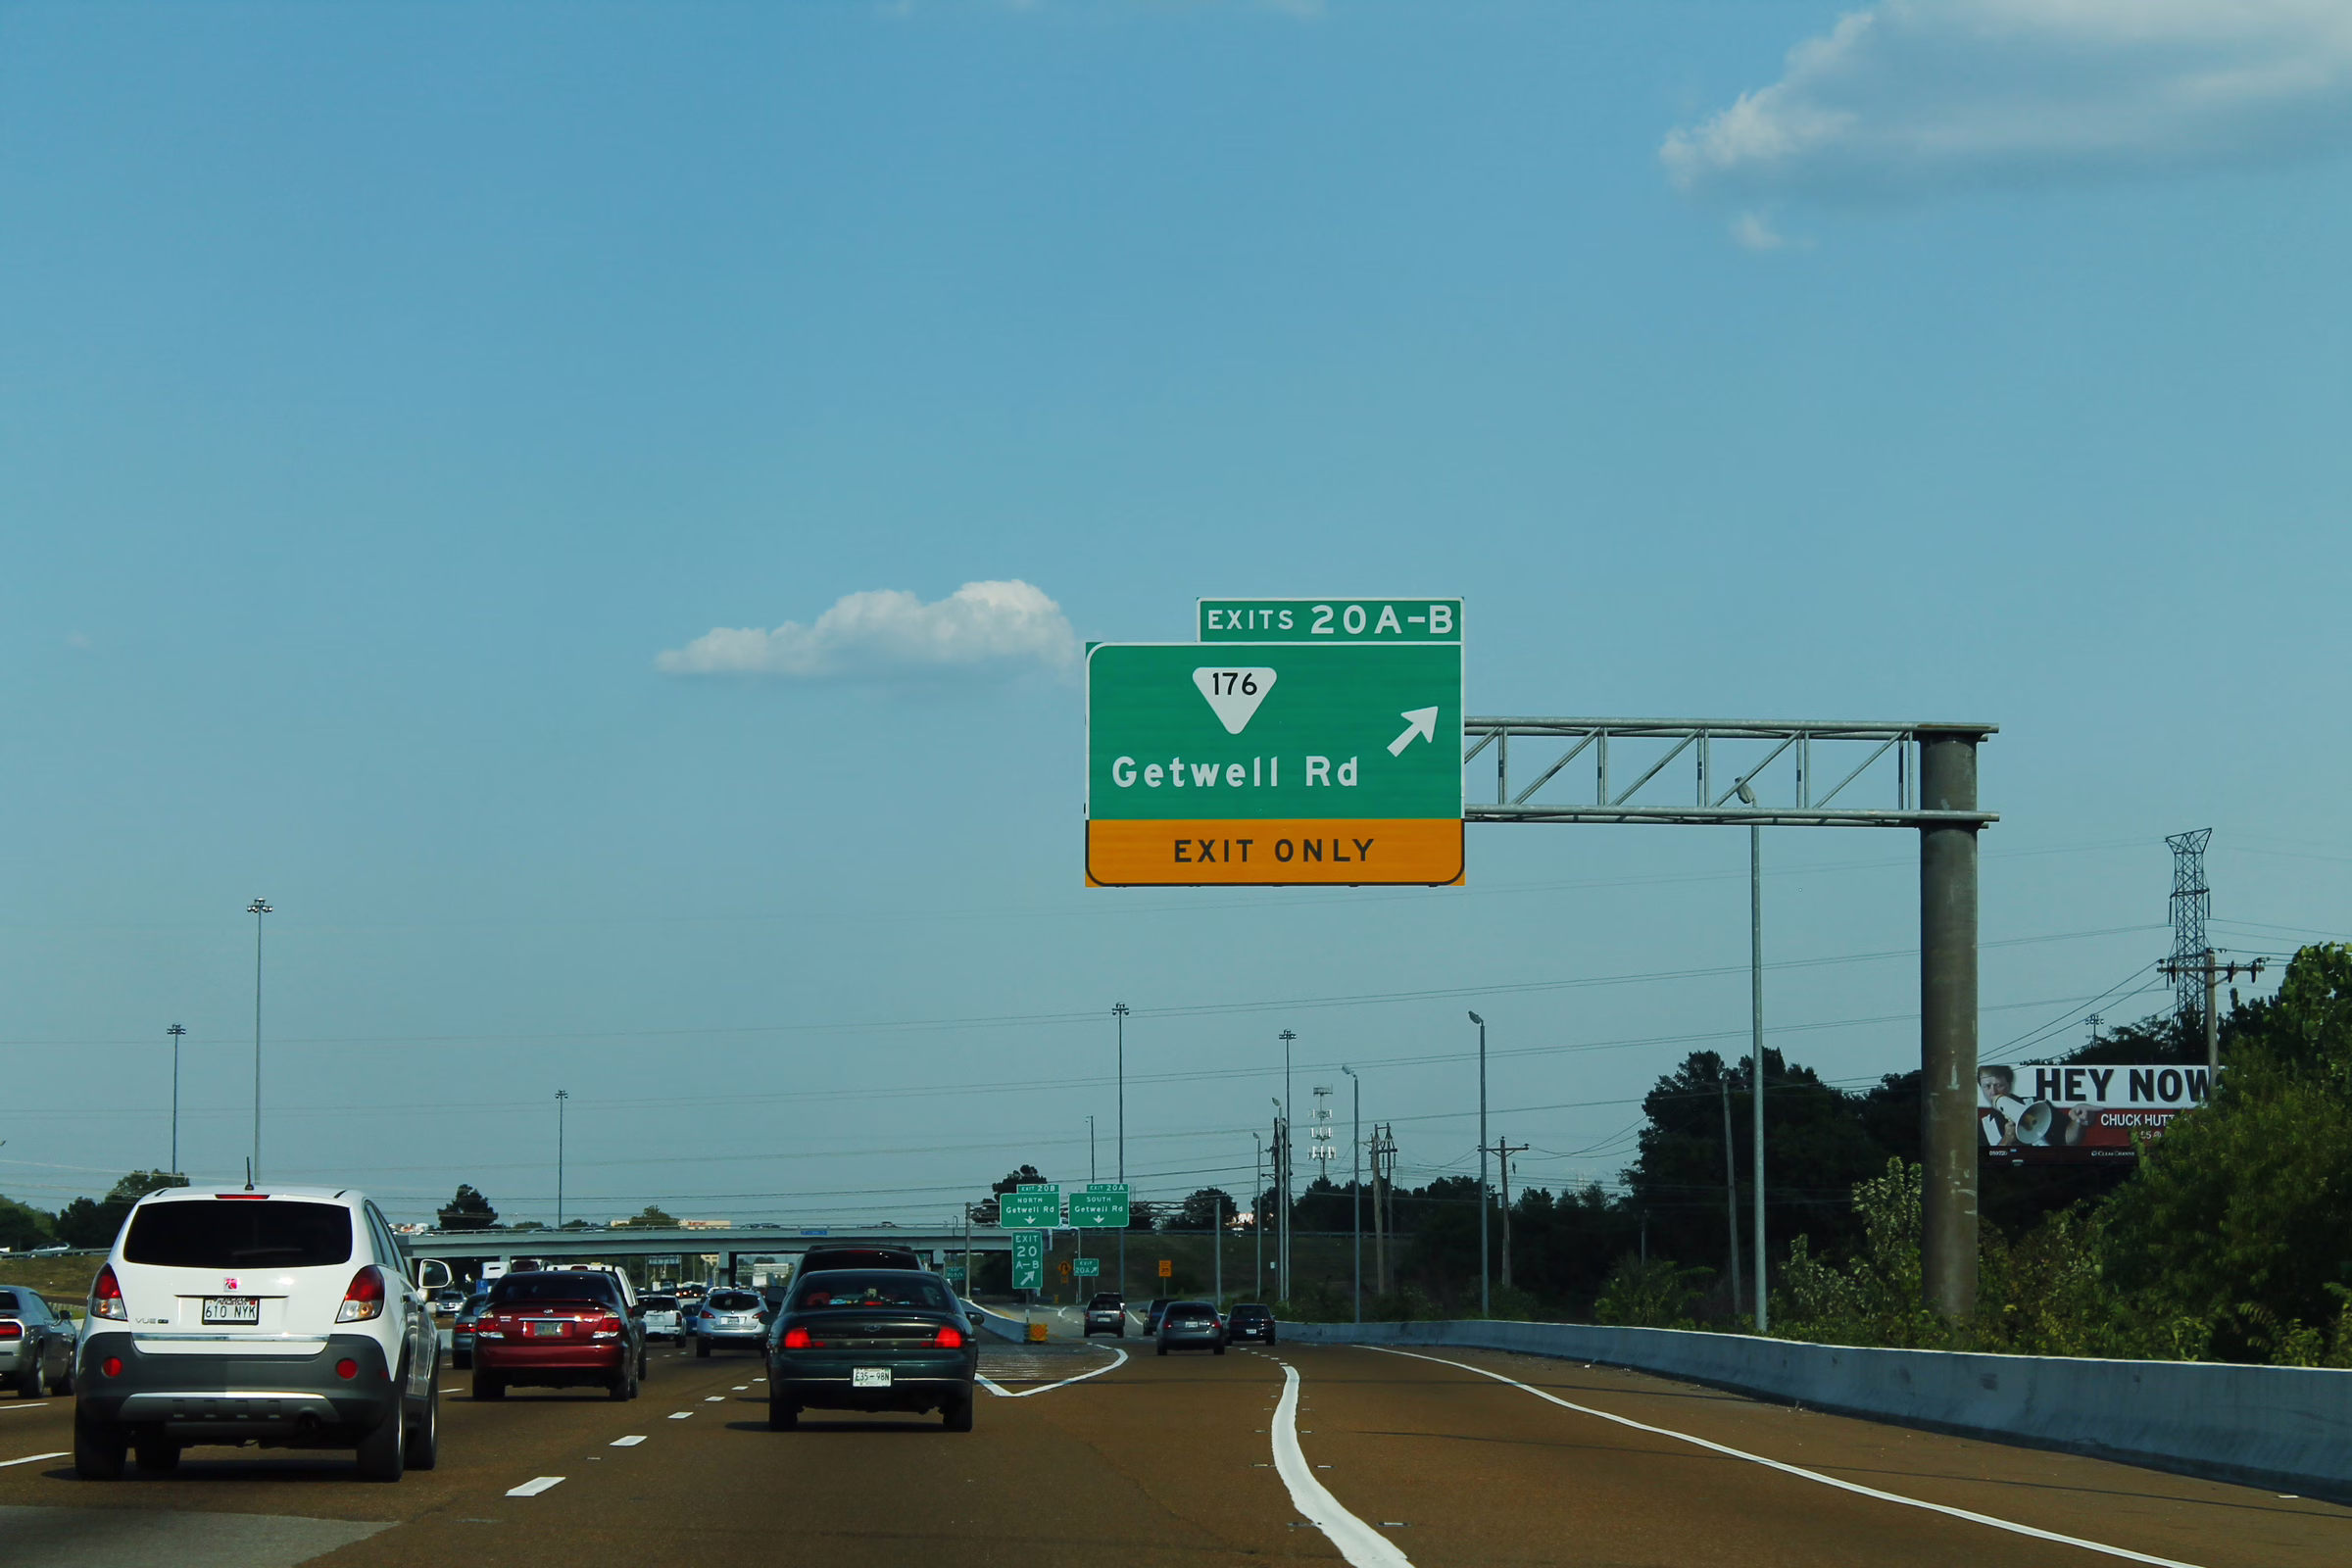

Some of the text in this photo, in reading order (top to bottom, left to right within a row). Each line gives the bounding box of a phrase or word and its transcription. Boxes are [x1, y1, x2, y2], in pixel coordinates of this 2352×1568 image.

[1207, 605, 1453, 634] EXITS 20A-B
[1211, 672, 1258, 696] 176
[1112, 756, 1358, 787] Getwell Rd
[1174, 839, 1374, 862] EXIT ONLY
[2035, 1068, 2210, 1102] HEY NOW
[2100, 1113, 2141, 1126] CHUCK
[1016, 1246, 1038, 1257] 20
[1015, 1260, 1040, 1269] A-B
[205, 1306, 256, 1318] 610 NYK
